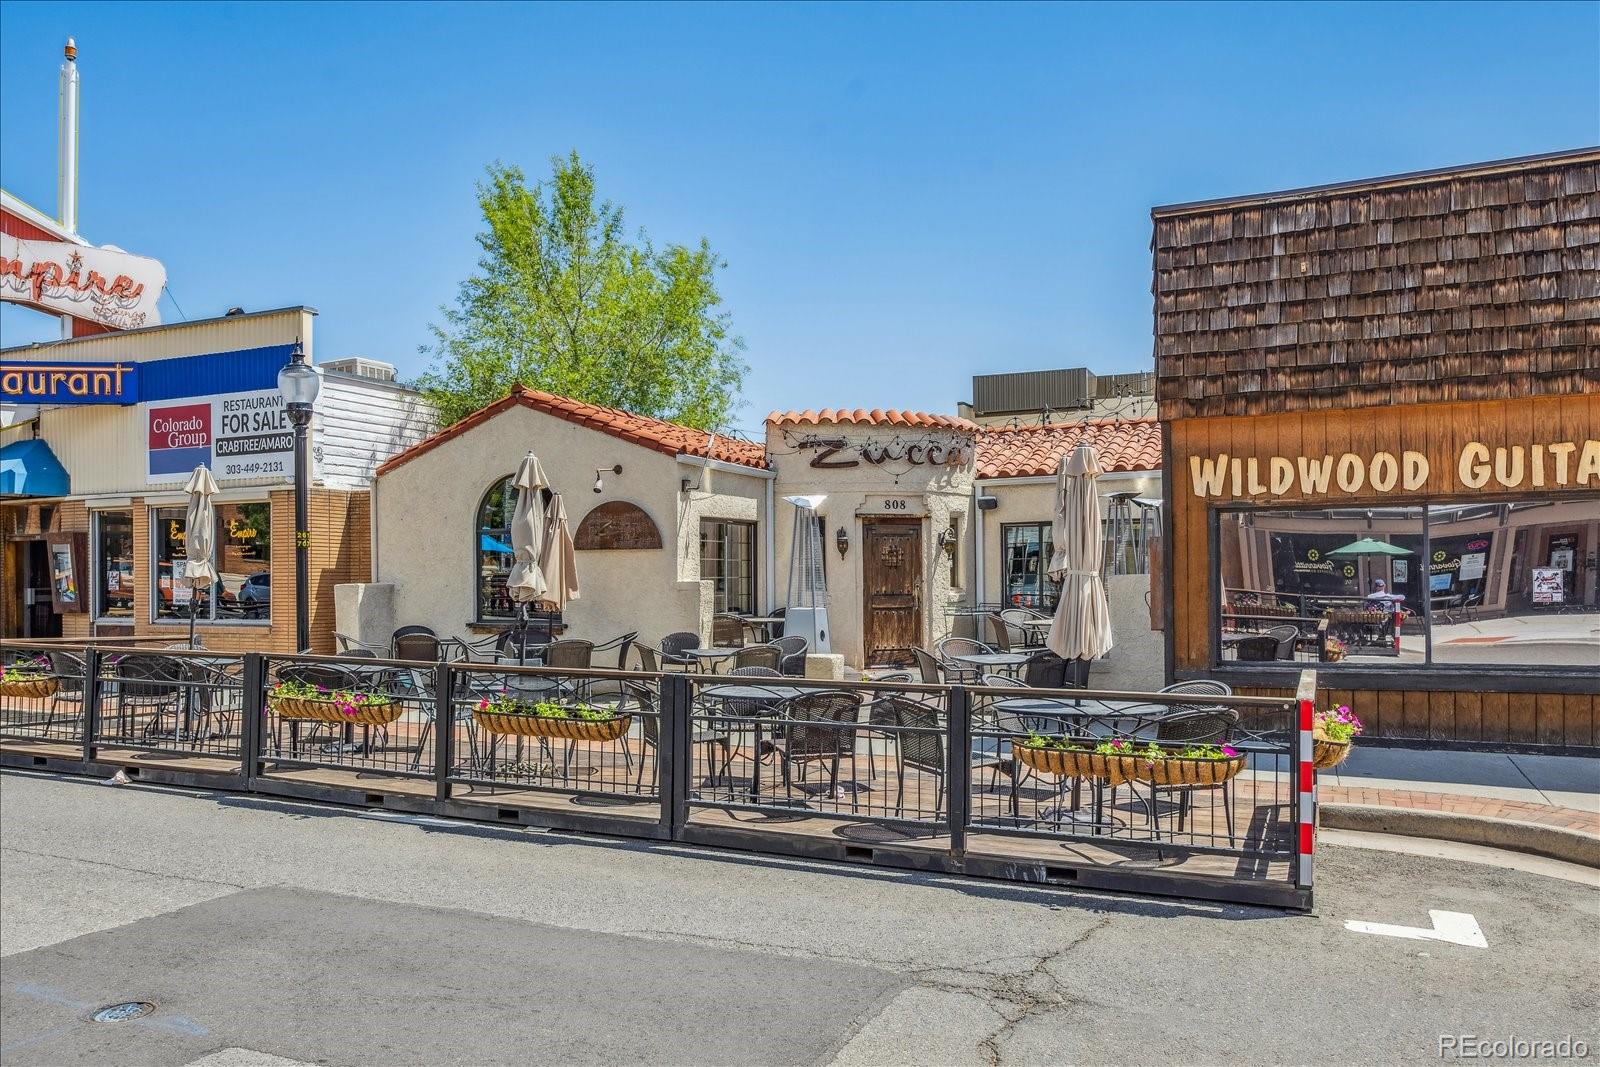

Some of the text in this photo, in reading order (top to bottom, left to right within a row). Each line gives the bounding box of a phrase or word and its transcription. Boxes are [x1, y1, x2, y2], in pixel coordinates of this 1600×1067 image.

[223, 396, 284, 412] RESTAURANT
[153, 416, 203, 433] Colorado
[222, 409, 287, 434] FOR SALE
[168, 431, 207, 449] Group
[217, 436, 293, 454] CRABTREE/AMARO
[798, 440, 970, 468] Zucca
[226, 461, 284, 475] 303-449-2131
[1190, 451, 1430, 498] WILDWOOD
[884, 500, 906, 510] 808
